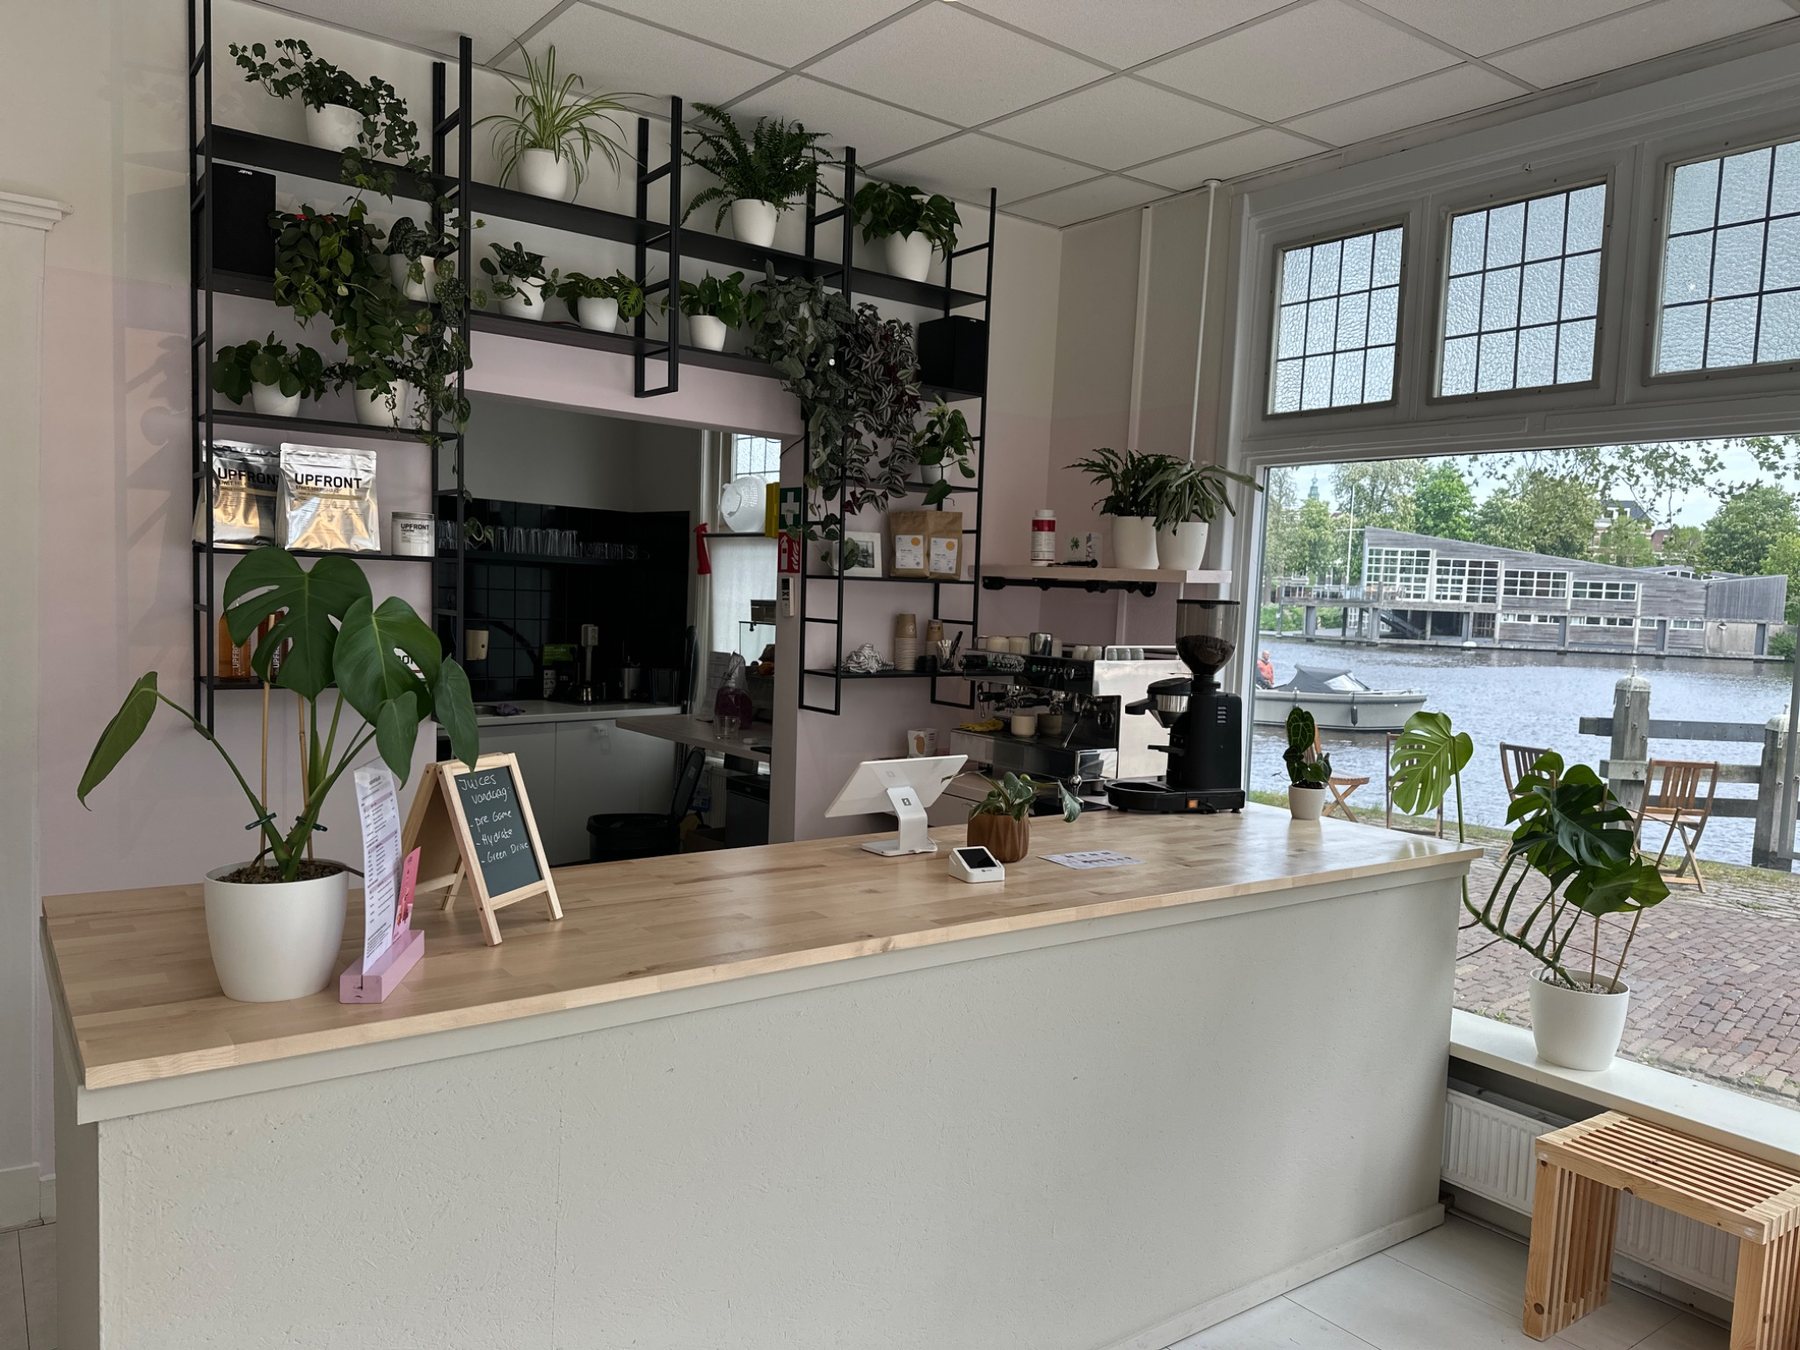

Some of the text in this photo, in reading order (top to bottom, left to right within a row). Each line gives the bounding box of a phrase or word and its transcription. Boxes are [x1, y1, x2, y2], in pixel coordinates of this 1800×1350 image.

[295, 473, 362, 489] UPFRONT
[400, 523, 430, 531] UPFRONT
[492, 810, 512, 822] Game
[487, 850, 507, 863] Green
